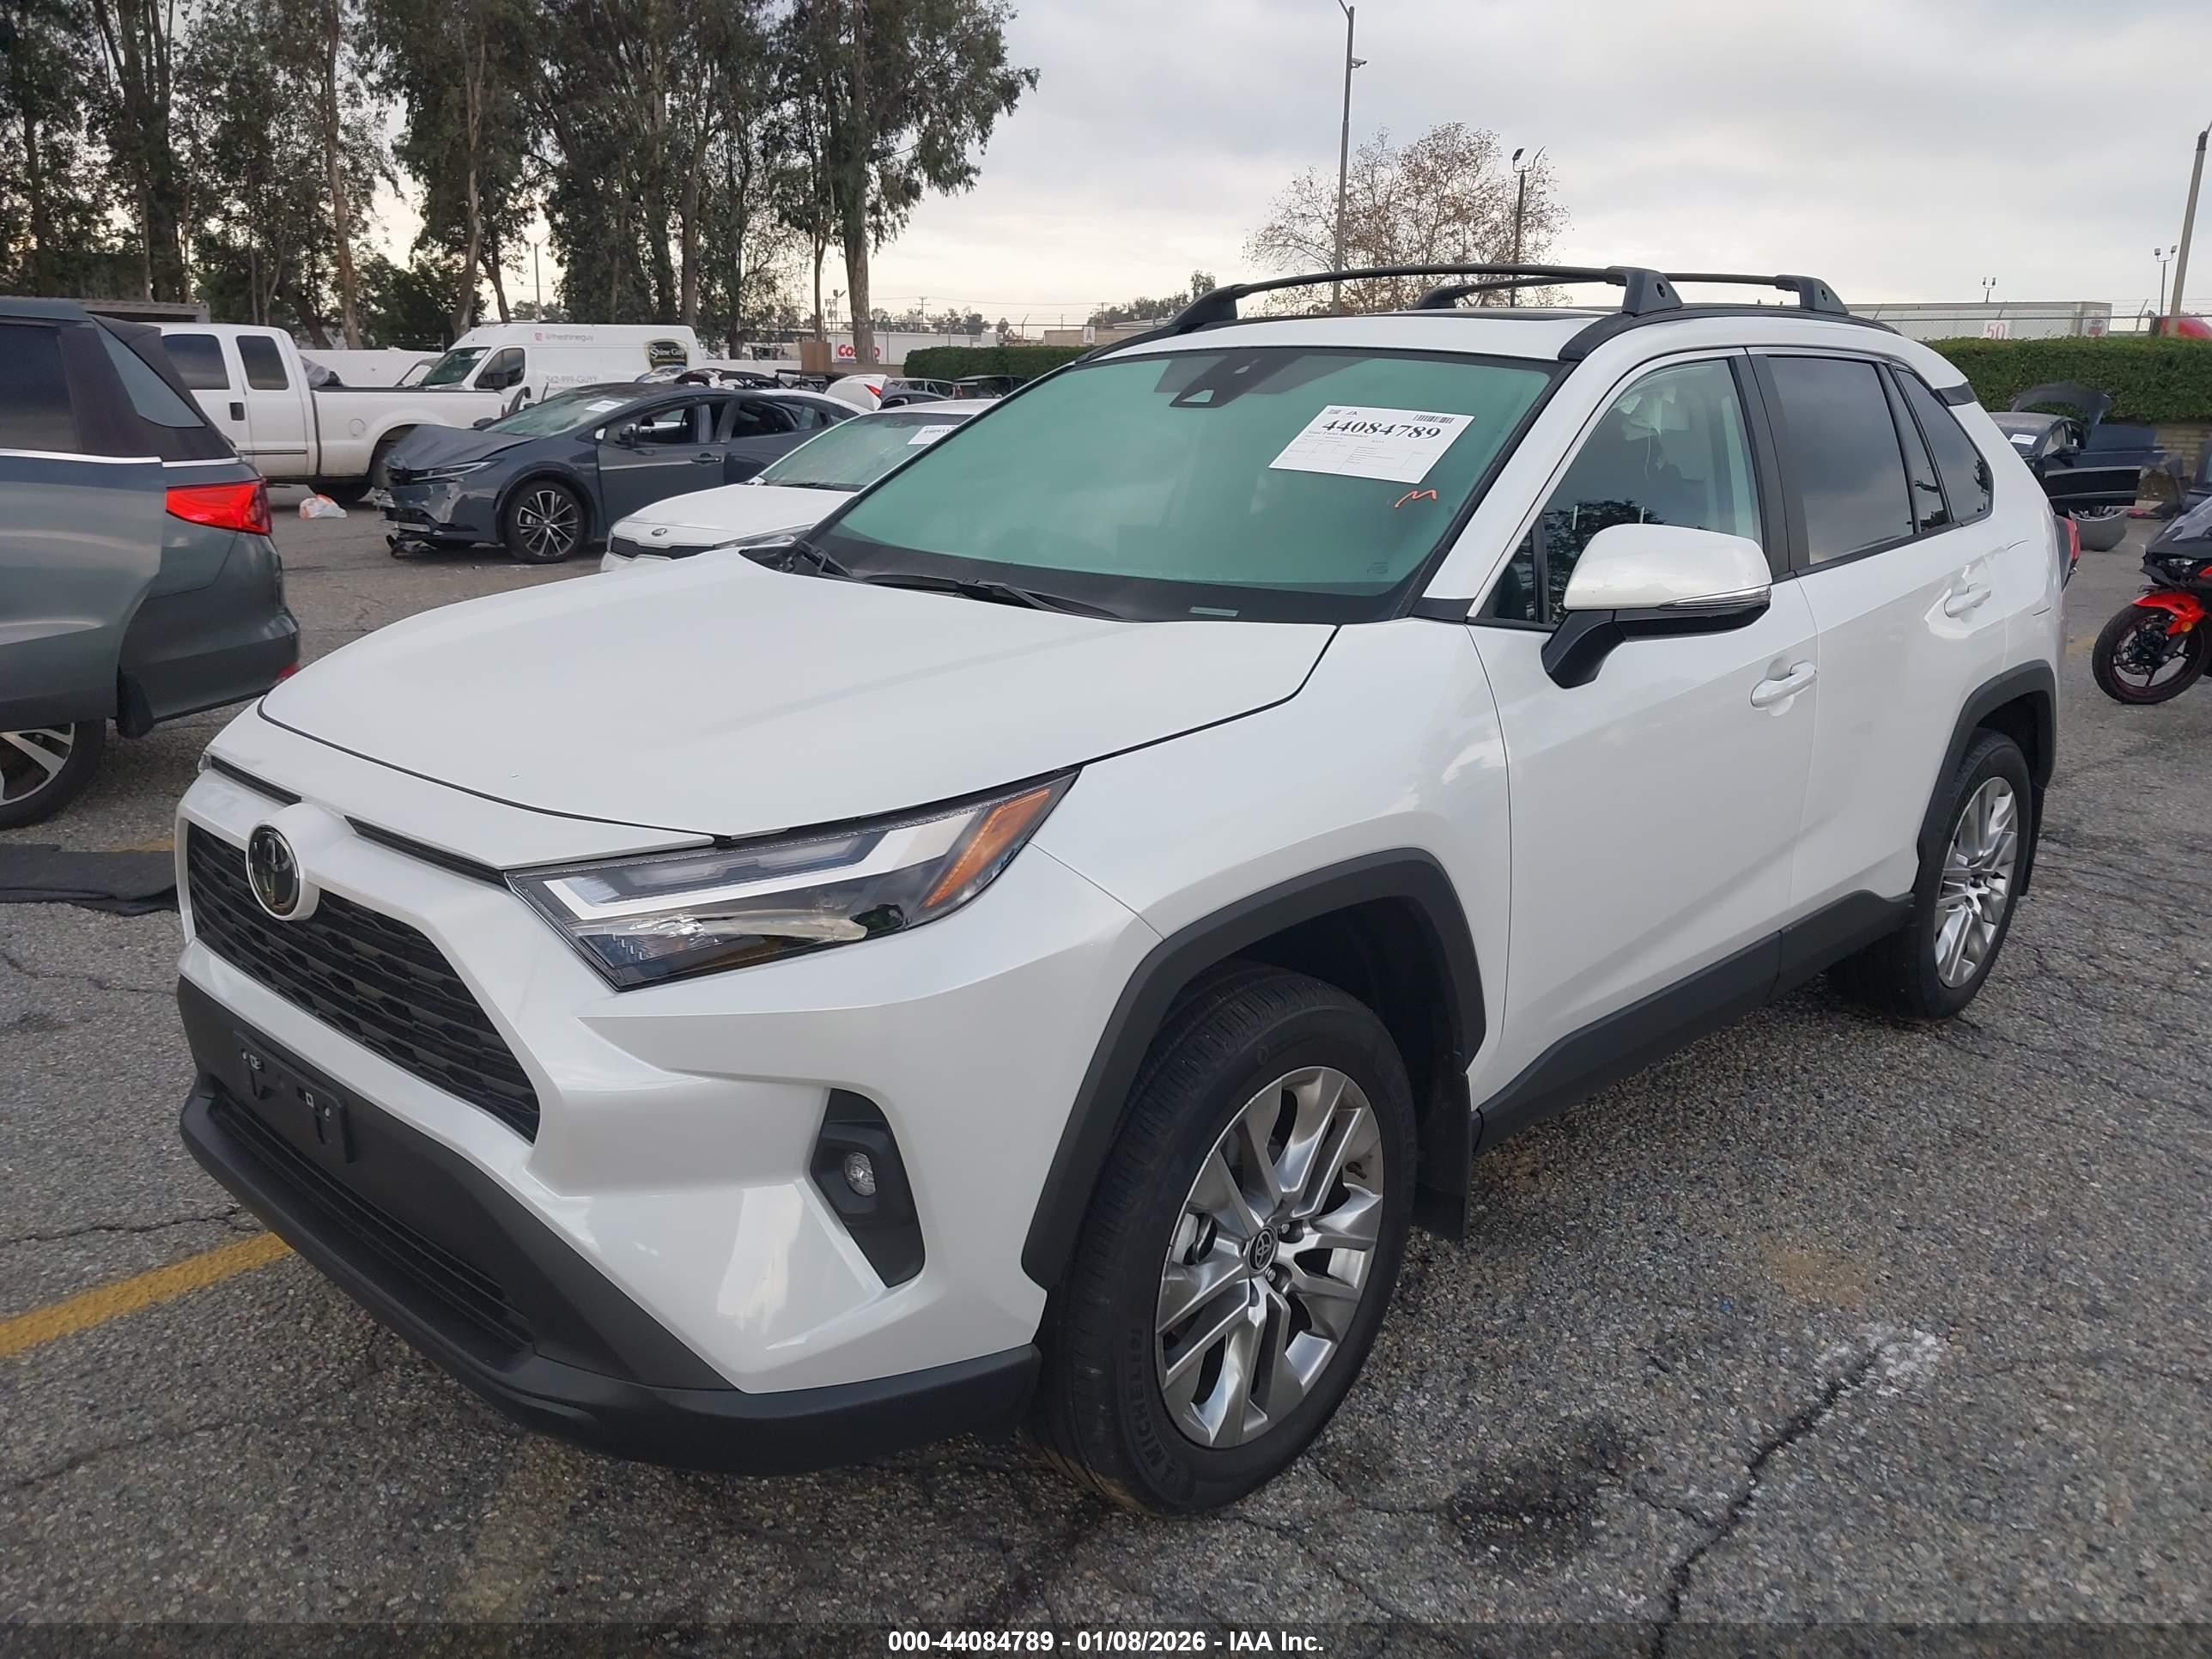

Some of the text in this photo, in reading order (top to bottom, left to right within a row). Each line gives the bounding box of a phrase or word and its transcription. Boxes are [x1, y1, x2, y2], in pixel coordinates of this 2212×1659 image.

[1085, 328, 1092, 341] A
[1986, 323, 2006, 339] 50
[838, 344, 880, 357] Coo
[1322, 420, 1442, 440] 44084789
